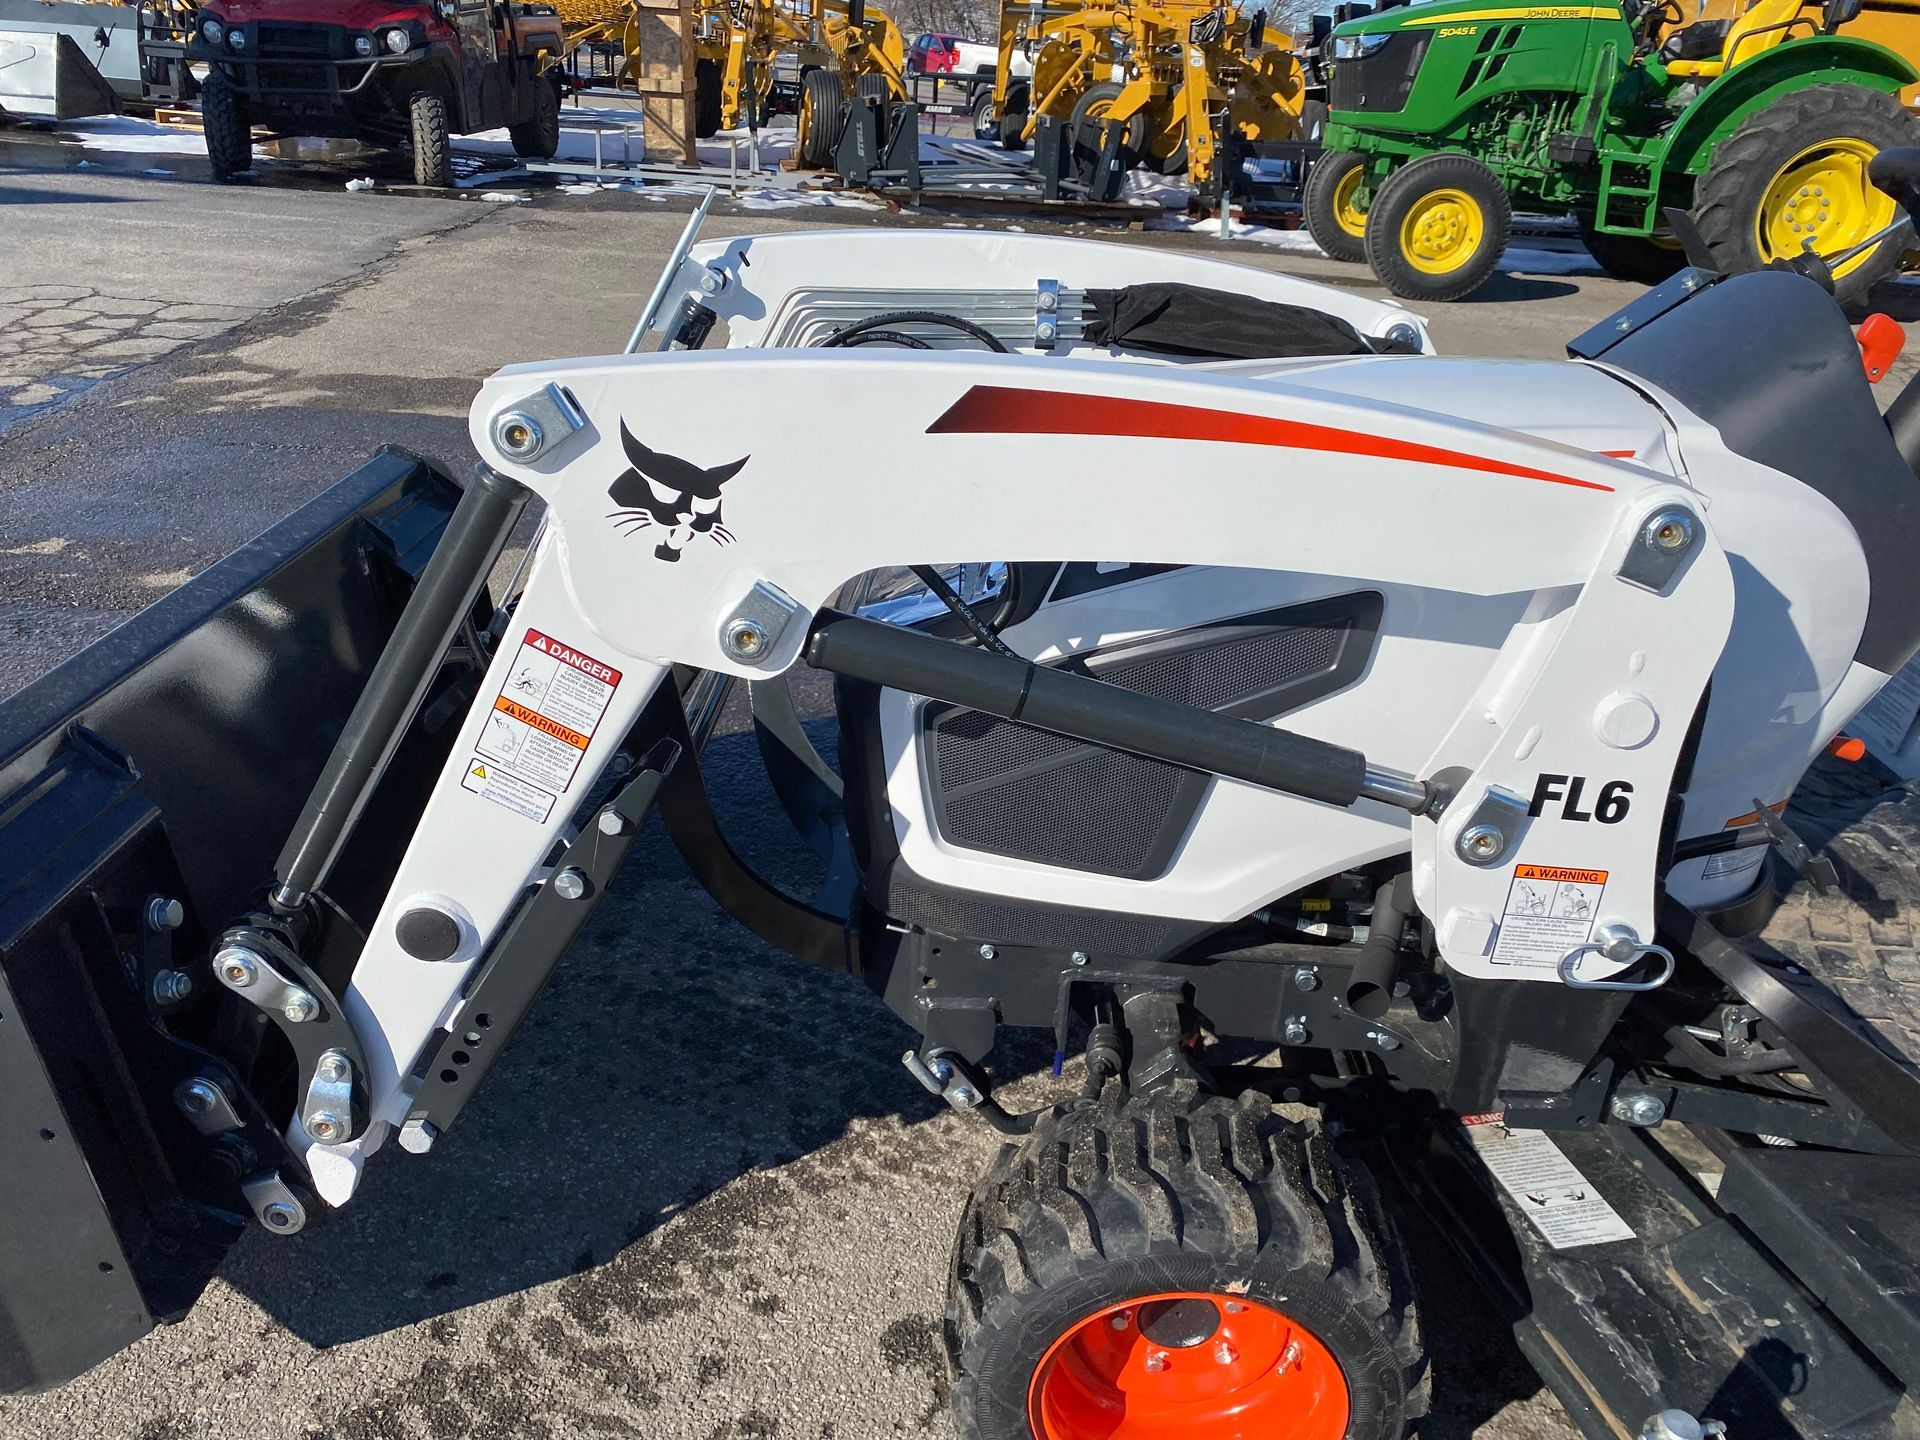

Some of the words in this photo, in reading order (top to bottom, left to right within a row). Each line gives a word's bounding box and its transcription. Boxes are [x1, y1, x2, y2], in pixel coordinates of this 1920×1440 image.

[1524, 9, 1550, 18] JOHN
[548, 643, 612, 681] DANGER
[560, 674, 578, 685] INJURY
[587, 687, 604, 698] DEATH
[564, 670, 582, 681] CAUSE
[581, 679, 604, 692] SERIOUS
[566, 666, 593, 681] CRUSHING
[593, 679, 605, 687] WILL
[516, 707, 581, 745] WARNING
[529, 739, 562, 757] ATTACHMENT
[530, 734, 551, 746] LOADER
[553, 744, 567, 754] ARMS
[537, 731, 558, 744] FALLING
[558, 742, 573, 751] FROM
[525, 748, 543, 759] INJURY
[551, 761, 568, 771] DEATH
[529, 744, 546, 755] CAUSE
[546, 753, 568, 766] SERIOUS
[519, 783, 536, 794] Cancer
[1527, 773, 1634, 824] FL6
[1539, 868, 1598, 881] WARNING
